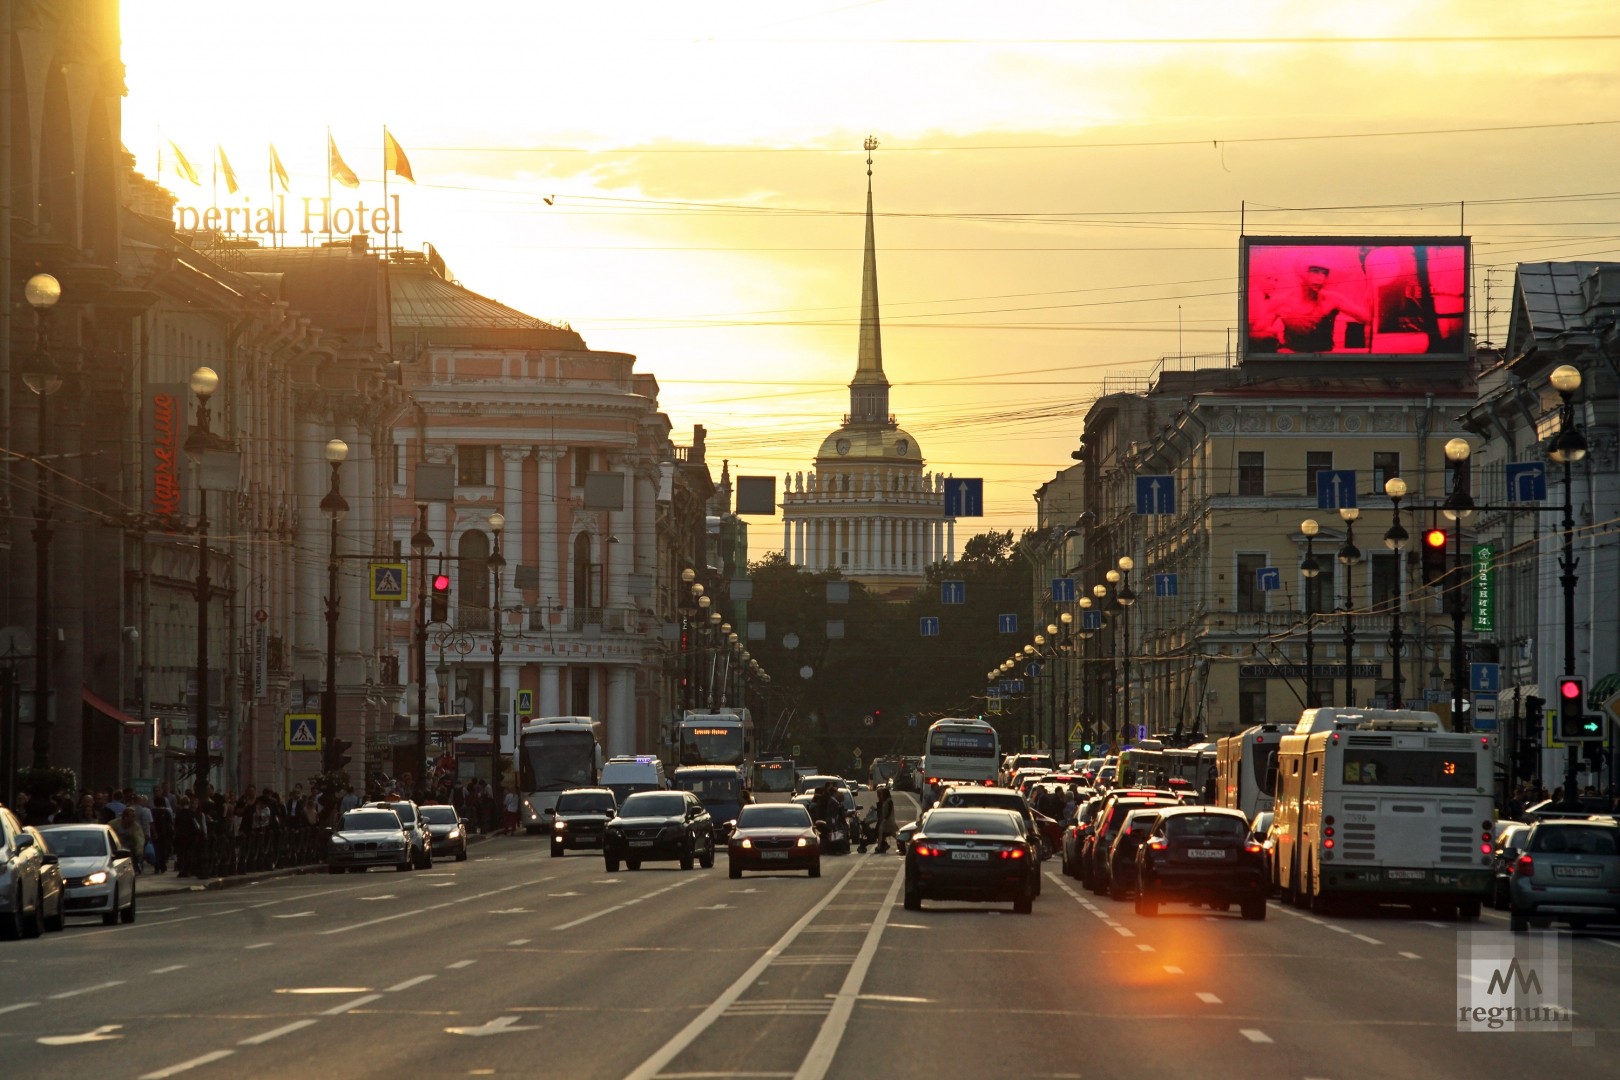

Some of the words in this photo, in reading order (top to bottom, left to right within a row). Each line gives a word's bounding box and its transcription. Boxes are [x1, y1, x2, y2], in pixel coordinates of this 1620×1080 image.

[301, 194, 403, 235] Hotel
[255, 627, 263, 662] AIRLINES
[255, 662, 263, 695] TURKISH
[1320, 665, 1381, 677] БЕРНЖЕ
